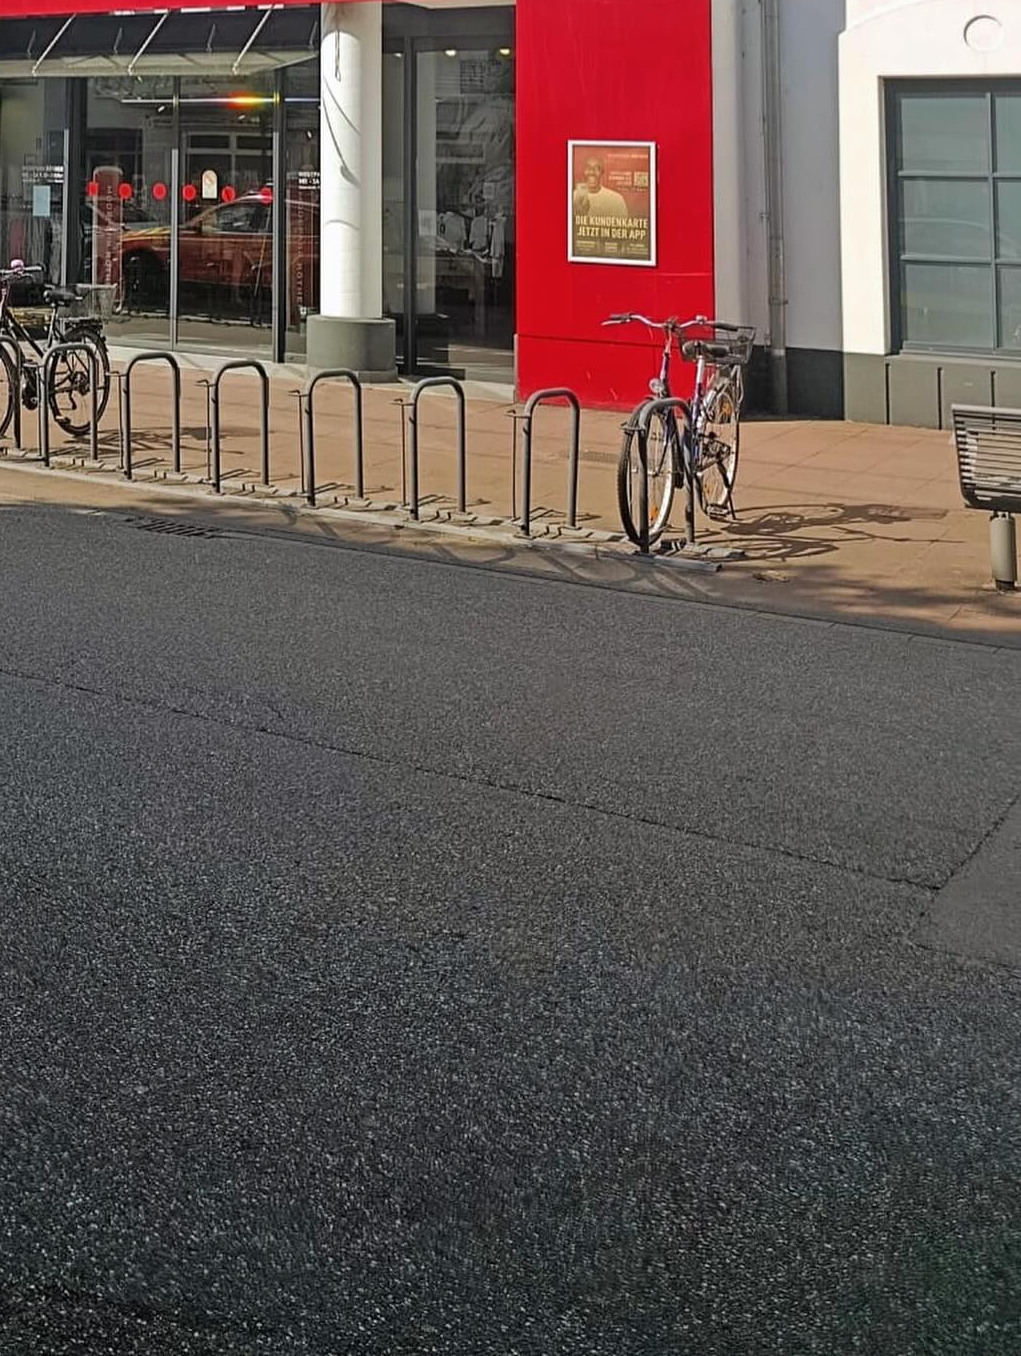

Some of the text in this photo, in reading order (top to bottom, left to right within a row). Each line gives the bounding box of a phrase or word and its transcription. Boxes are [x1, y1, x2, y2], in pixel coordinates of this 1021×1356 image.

[575, 216, 648, 229] DIE KUNDENKARTE
[578, 226, 646, 240] JETZT IN DER APP
